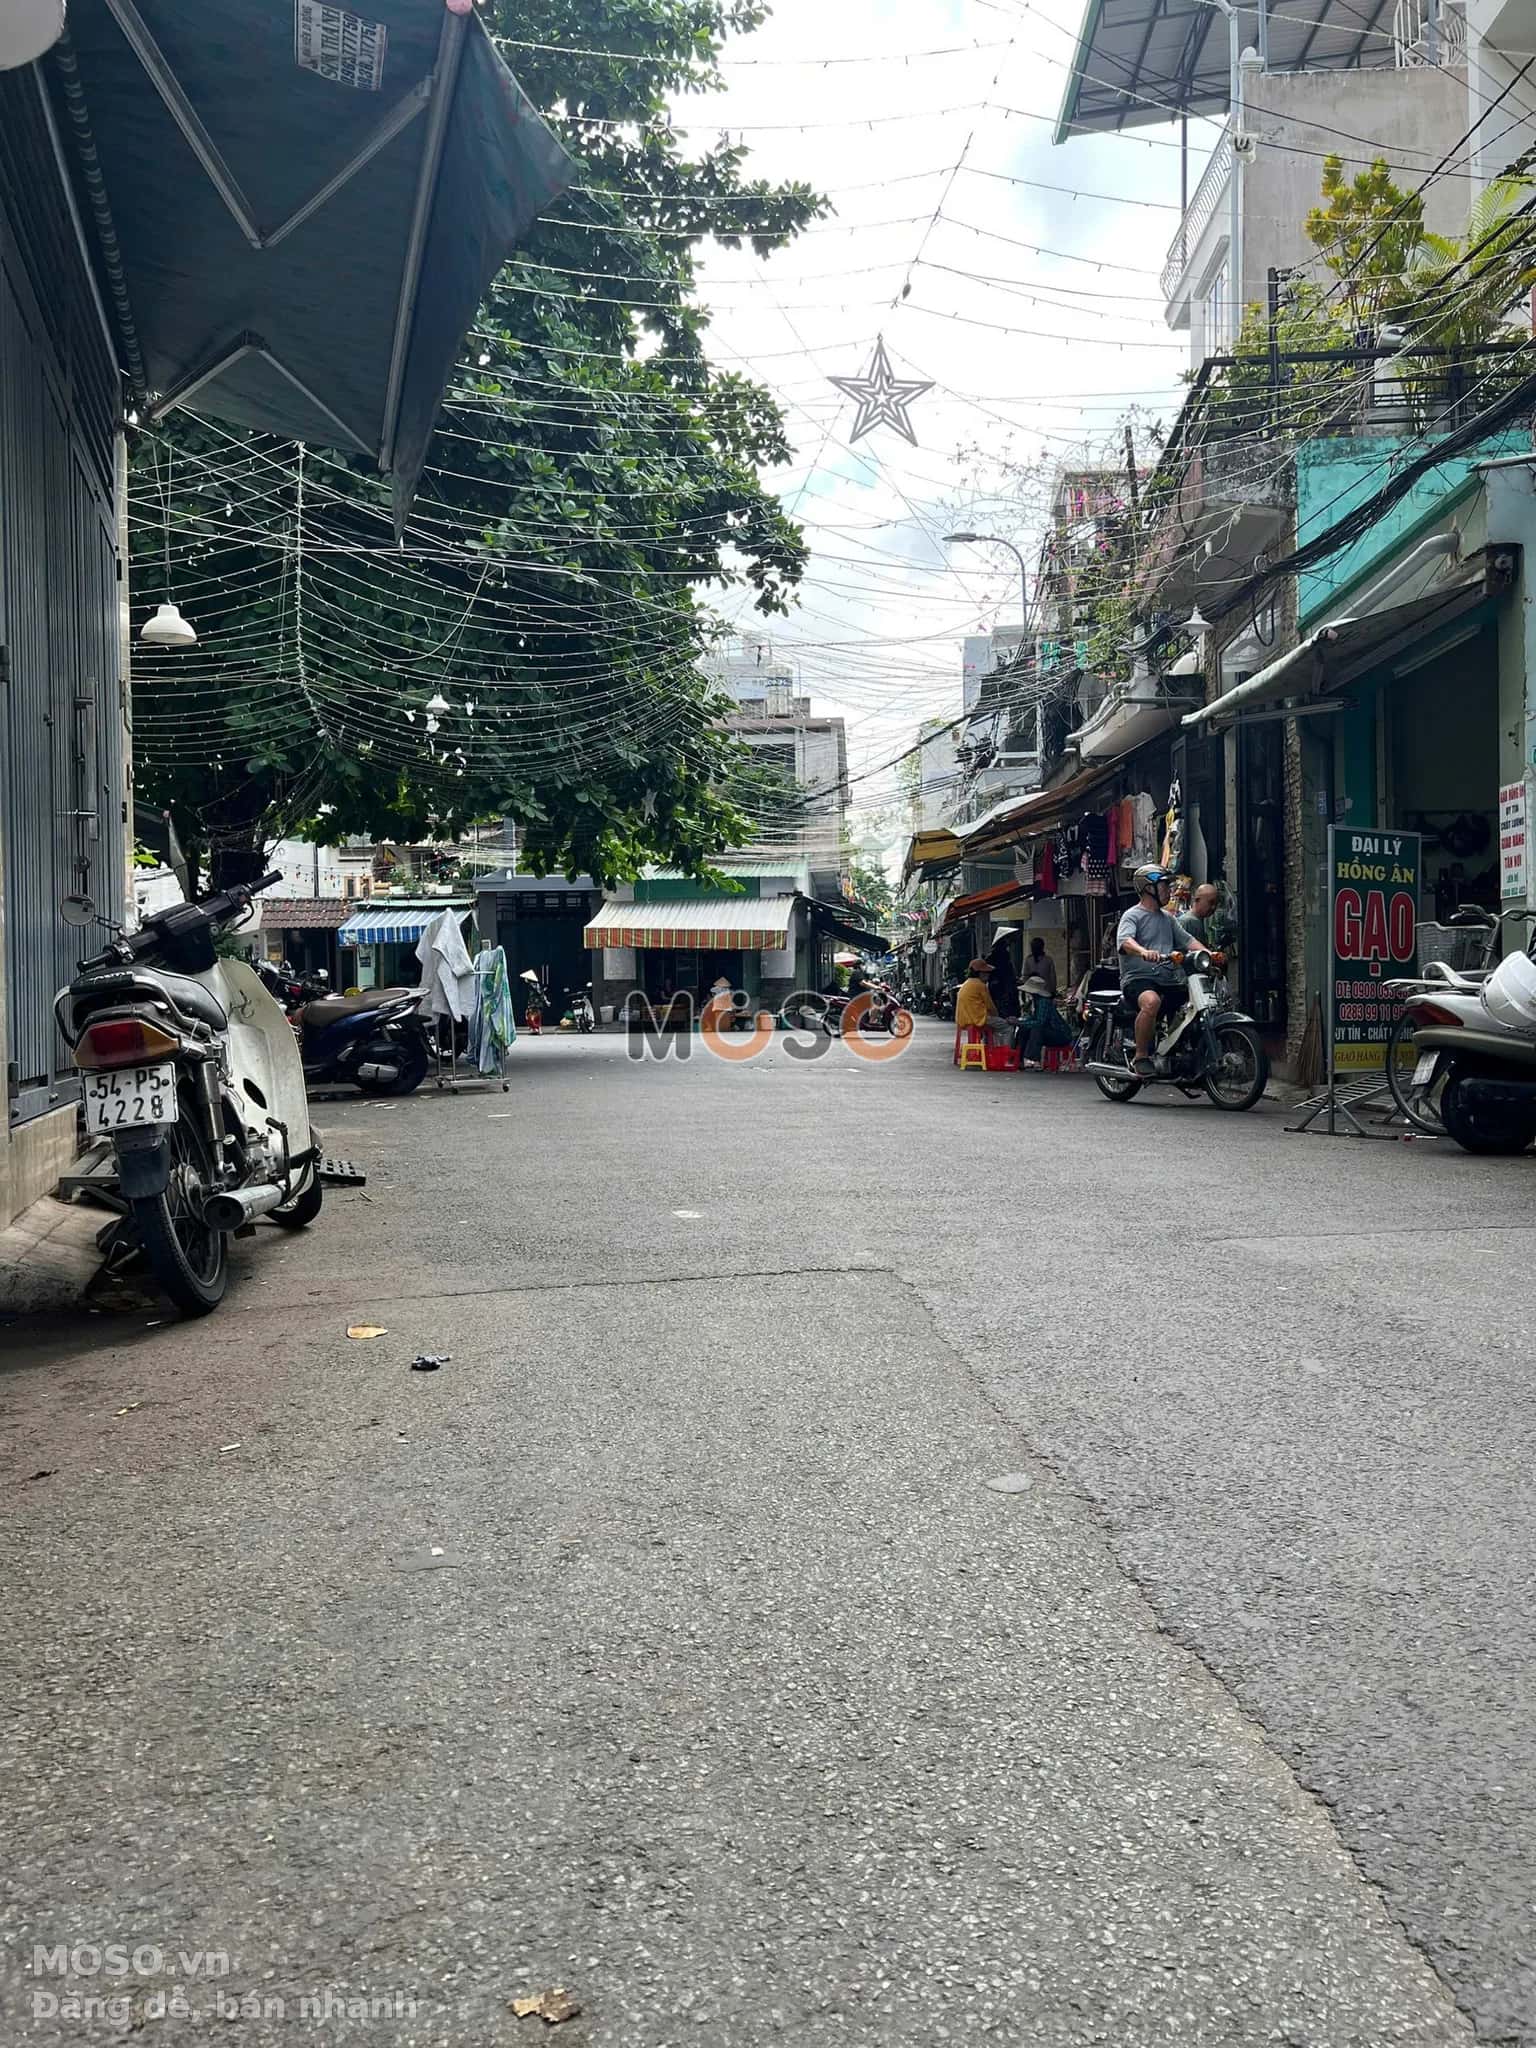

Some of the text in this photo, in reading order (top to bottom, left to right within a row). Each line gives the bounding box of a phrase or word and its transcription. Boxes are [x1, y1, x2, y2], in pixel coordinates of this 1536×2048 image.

[1352, 836, 1402, 856] ĐẠI LÝ
[1337, 856, 1415, 883] HỒNG ÂN
[1334, 887, 1416, 977] GẠO
[1352, 981, 1377, 999] 0908
[1340, 1003, 1364, 1021] 0283
[1365, 1004, 1377, 1021] 99
[1379, 1004, 1391, 1021] 11
[1347, 1024, 1361, 1040] TÍN
[1368, 1023, 1387, 1040] CHẤT
[96, 1068, 161, 1099] 54-P5
[99, 1095, 164, 1127] 4228
